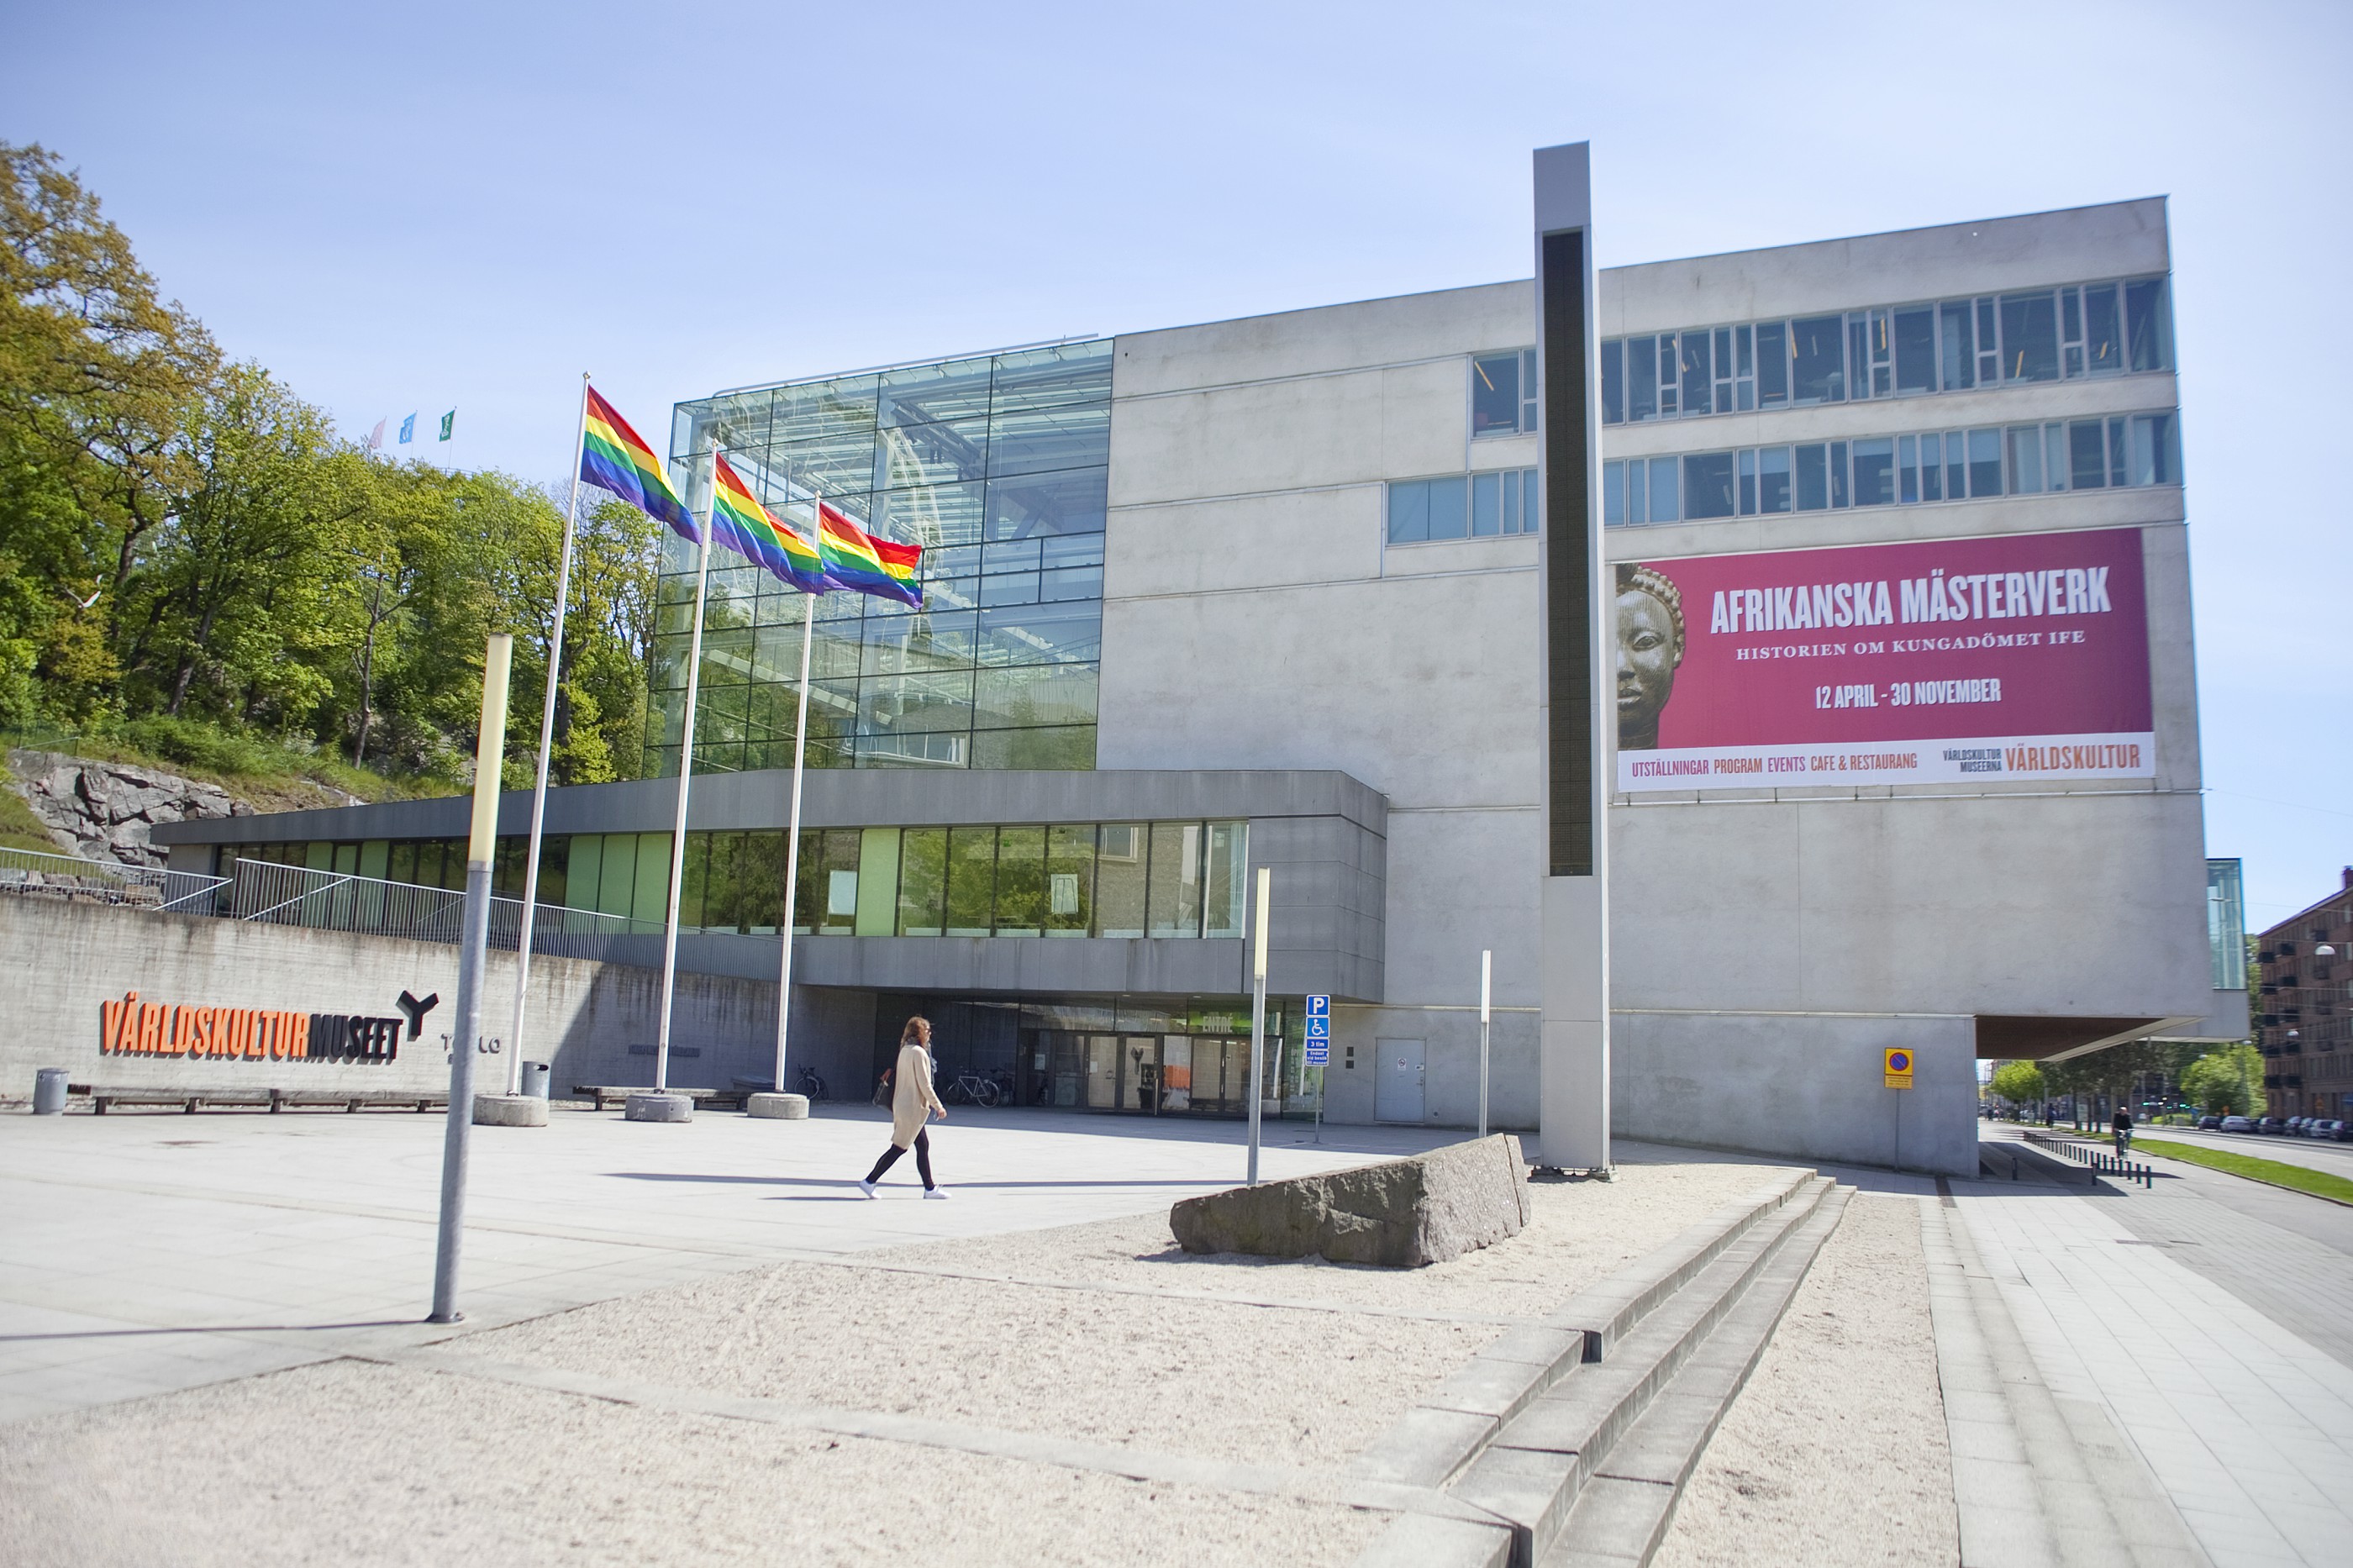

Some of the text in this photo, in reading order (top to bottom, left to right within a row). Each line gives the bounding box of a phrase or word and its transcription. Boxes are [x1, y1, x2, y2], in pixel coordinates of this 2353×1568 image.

[1711, 566, 2112, 634] AFRIKANSKA MÄSTERVERK
[1736, 630, 2086, 660] HISTORIEN OM KUNGADÖMET IFE
[1815, 686, 1831, 708] 12
[1834, 684, 1879, 708] APRIL
[1891, 682, 1911, 706] 30
[1914, 678, 2002, 705] NOVEMBER
[1632, 753, 1918, 777] UTSTÄLLNINGAR PROGRAM EVENTS CAFE & RESTAURANG
[1943, 748, 2002, 761] VÄRLDSKULTUR
[1960, 760, 2002, 772] MUSEERNA
[2005, 742, 2140, 771] VÄRLDSKULTUR
[1313, 997, 1324, 1013] P
[102, 992, 403, 1061] VÄRLDSKULTURMUSEET
[1203, 1013, 1233, 1033] ENTRÉ
